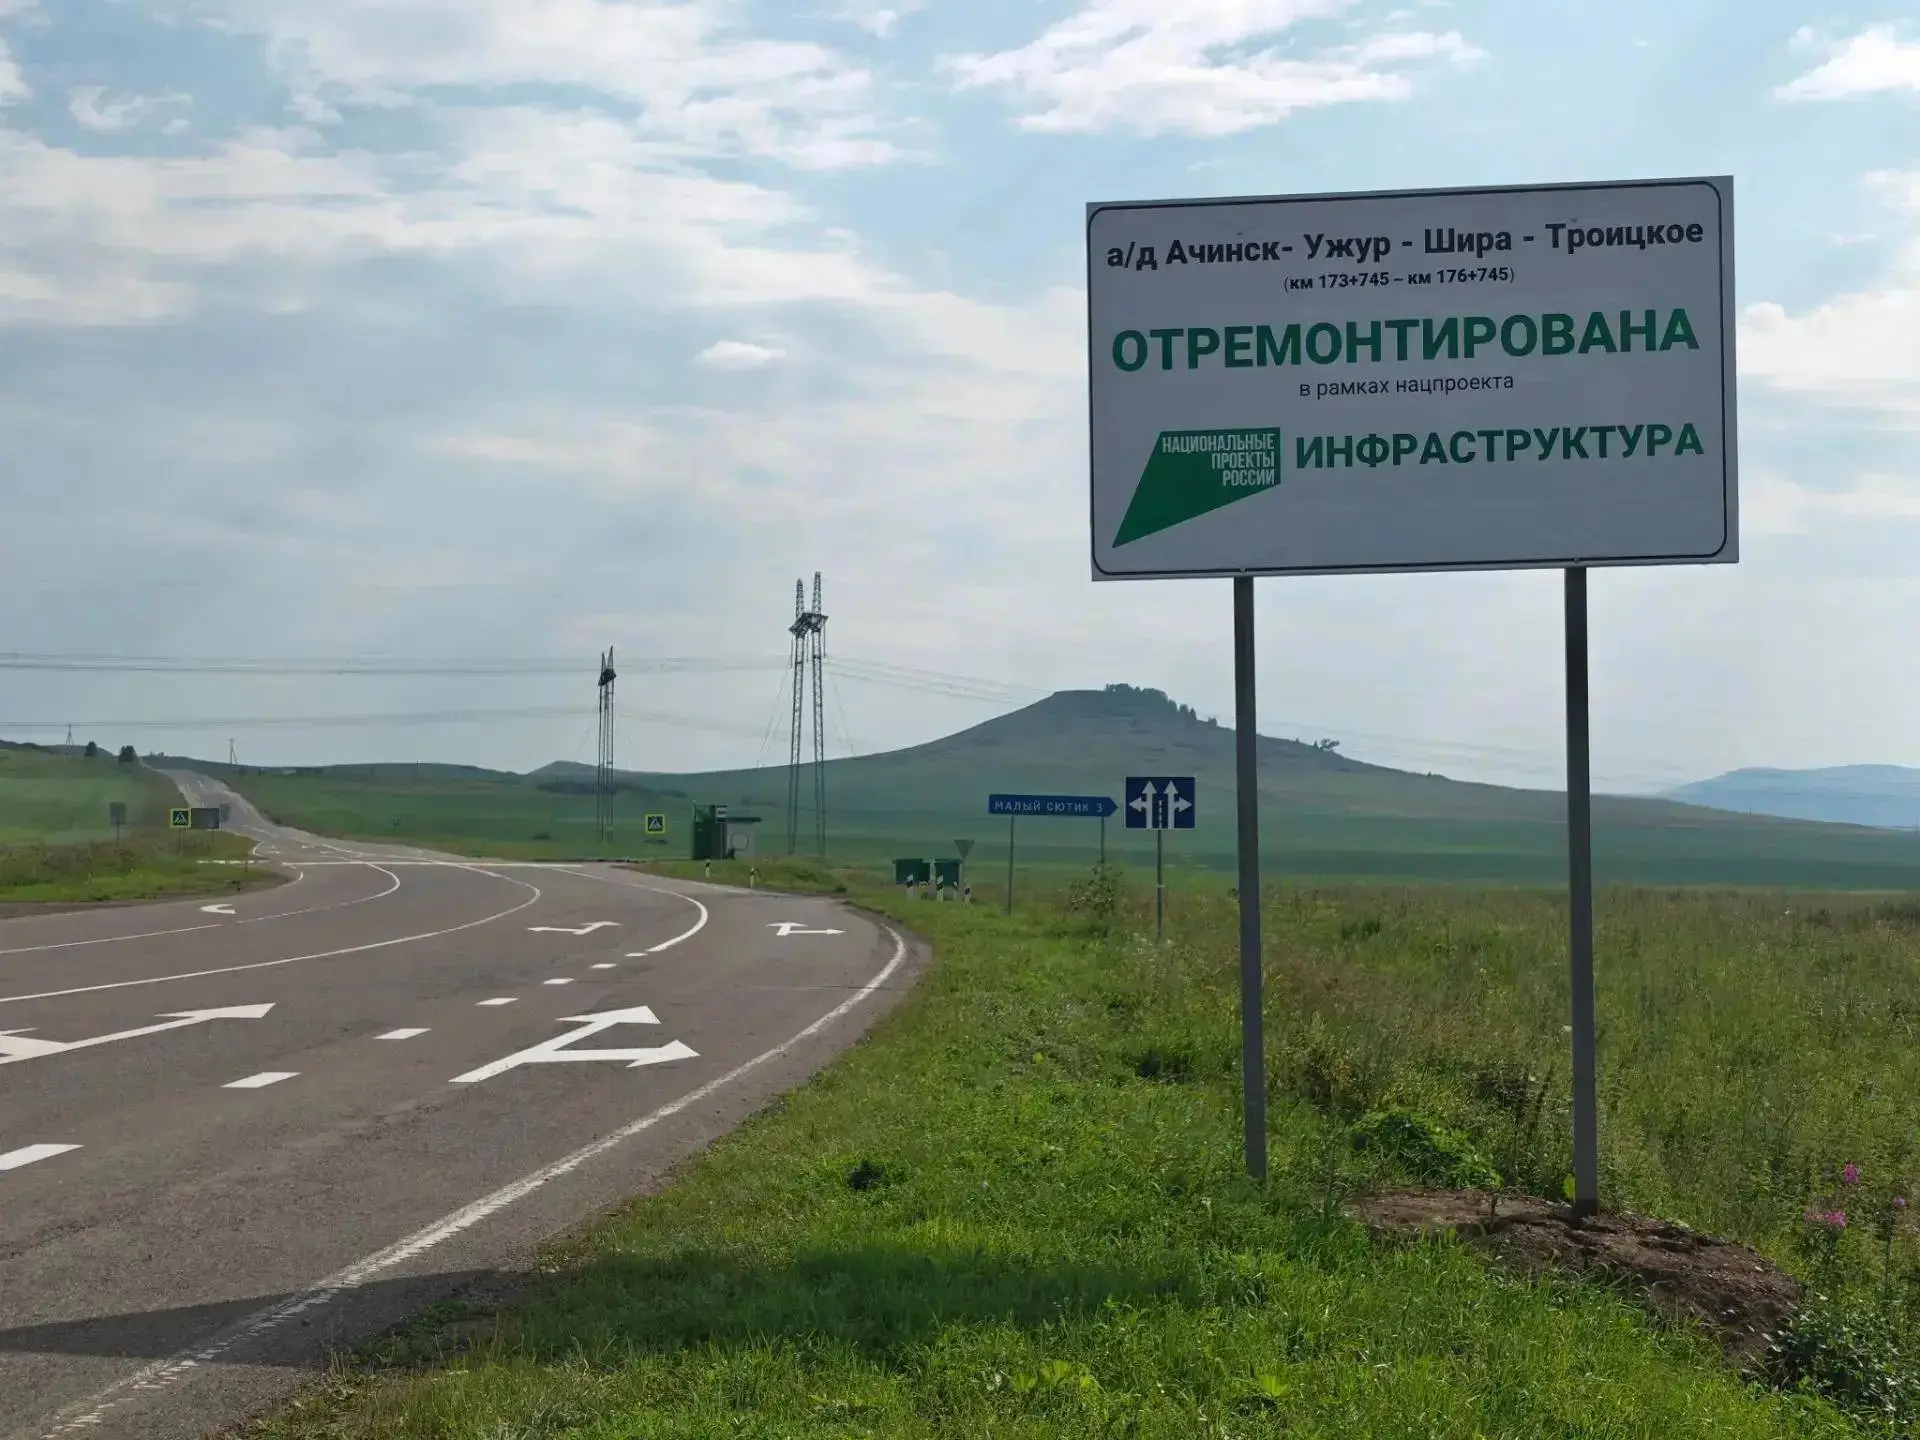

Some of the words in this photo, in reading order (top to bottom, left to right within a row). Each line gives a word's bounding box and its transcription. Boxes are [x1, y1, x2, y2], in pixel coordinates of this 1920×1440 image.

[1107, 242, 1158, 271] а/д
[1303, 233, 1391, 264] Ужур
[1424, 227, 1512, 258] Шира
[1544, 223, 1704, 255] Троицкое
[1283, 276, 1313, 292] (км
[1319, 271, 1389, 289] 173+745
[1407, 273, 1432, 285] км
[1436, 266, 1515, 284] 176+745)
[1112, 308, 1700, 373] ОТРЕМОНТИРОВАНА
[1299, 384, 1311, 397] в
[1316, 380, 1389, 401] рамках
[1396, 375, 1514, 396] нацпроекта
[1162, 433, 1275, 454] НАЦИОНАЛЬНЫЕ
[1296, 423, 1704, 469] ИНФРАСТРУКТУРА
[1211, 451, 1275, 469] ПРОЕКТЫ
[1222, 469, 1275, 487] РОССИИ
[994, 800, 1041, 813] МАЛЫЙ
[1046, 802, 1089, 813] СЮТИК
